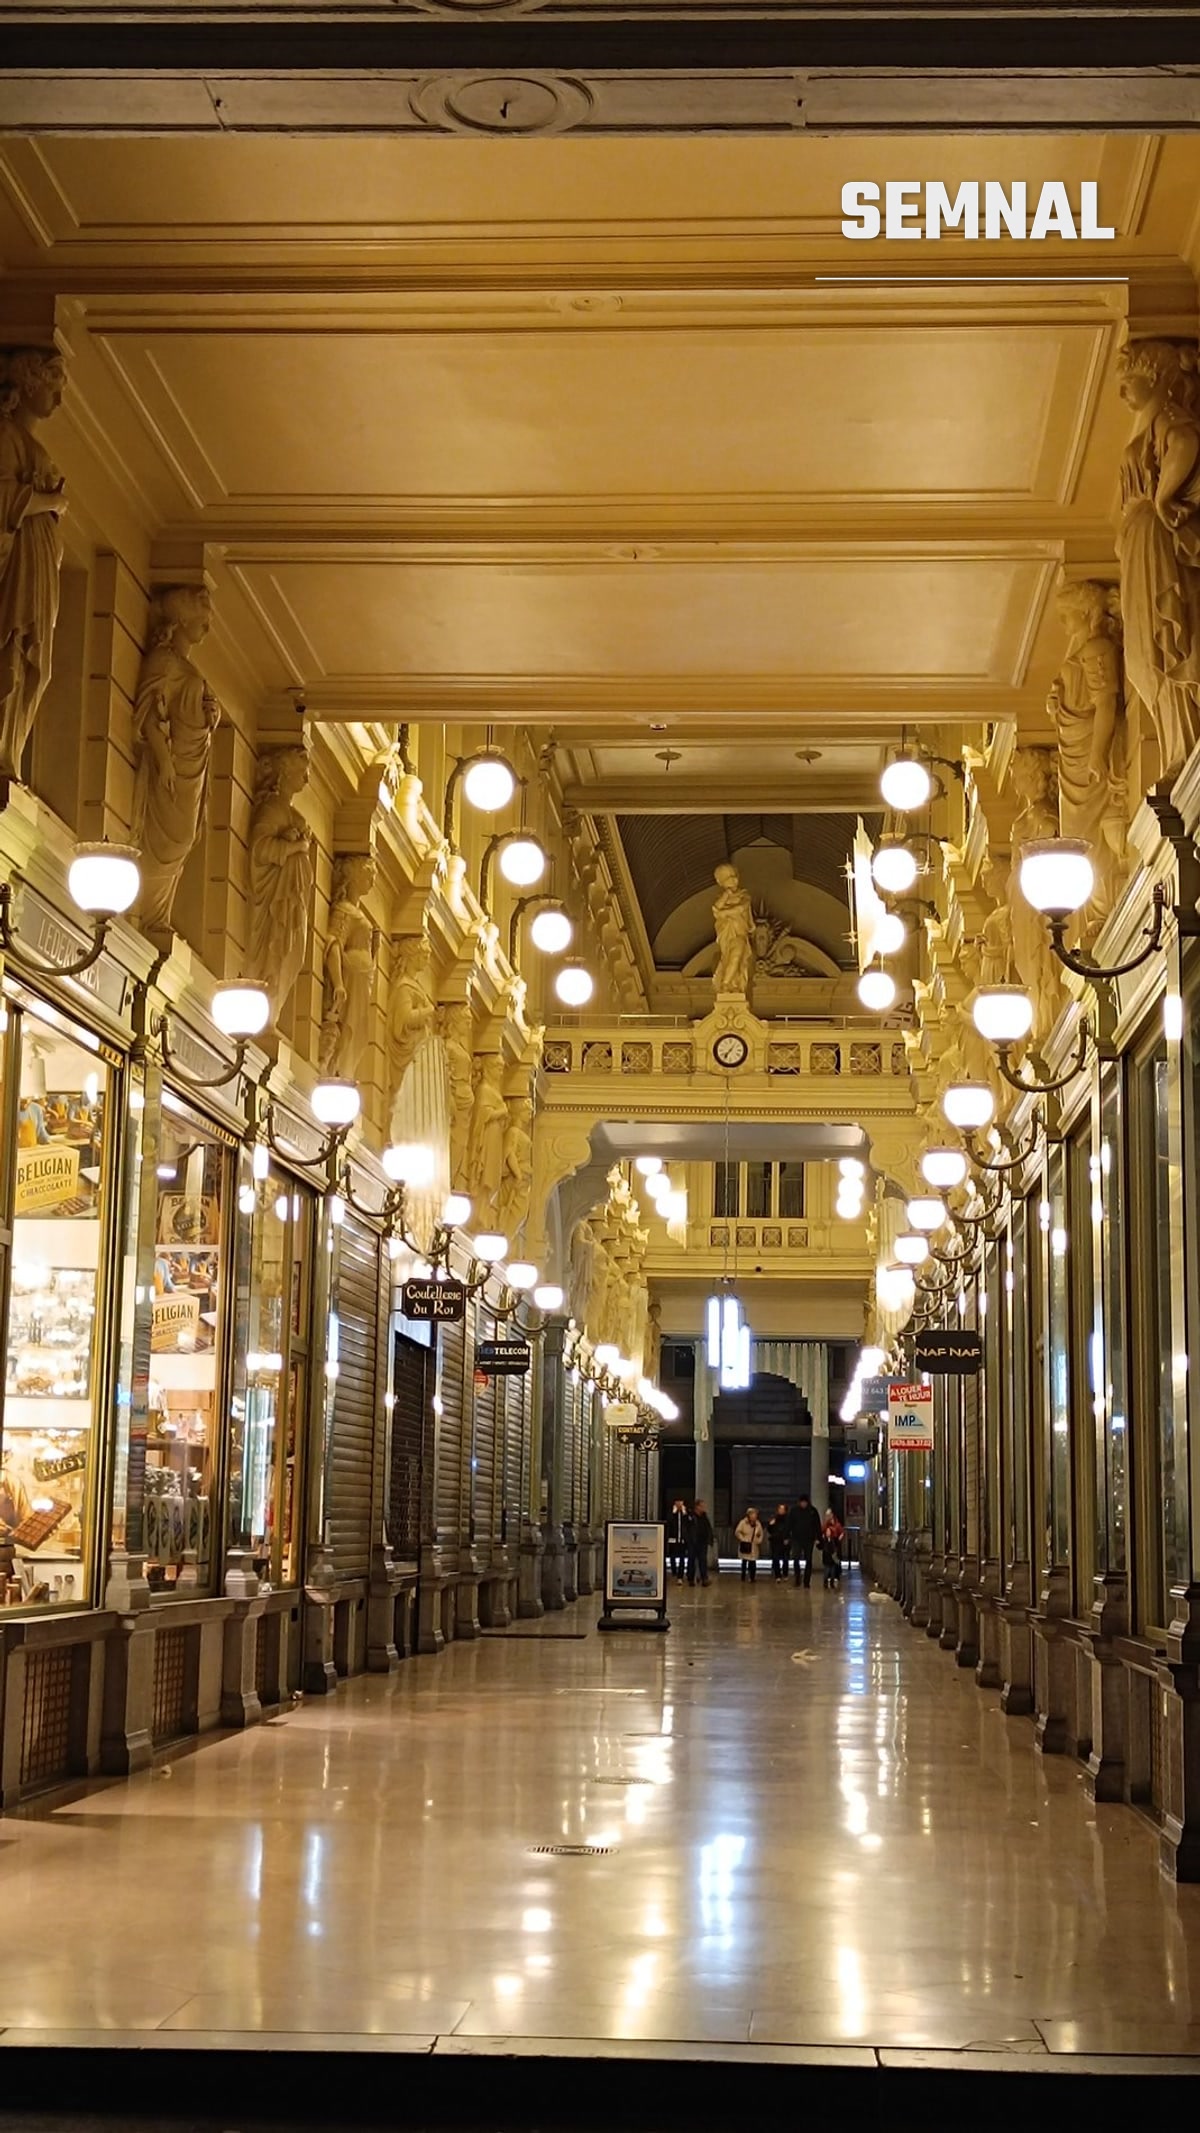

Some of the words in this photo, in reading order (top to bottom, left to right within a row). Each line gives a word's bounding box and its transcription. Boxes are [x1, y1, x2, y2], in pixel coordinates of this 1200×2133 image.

[413, 1302, 428, 1315] du
[433, 1300, 454, 1316] Roi
[915, 1347, 947, 1357] NAF
[949, 1346, 981, 1358] NAF
[894, 1415, 916, 1427] IMP
